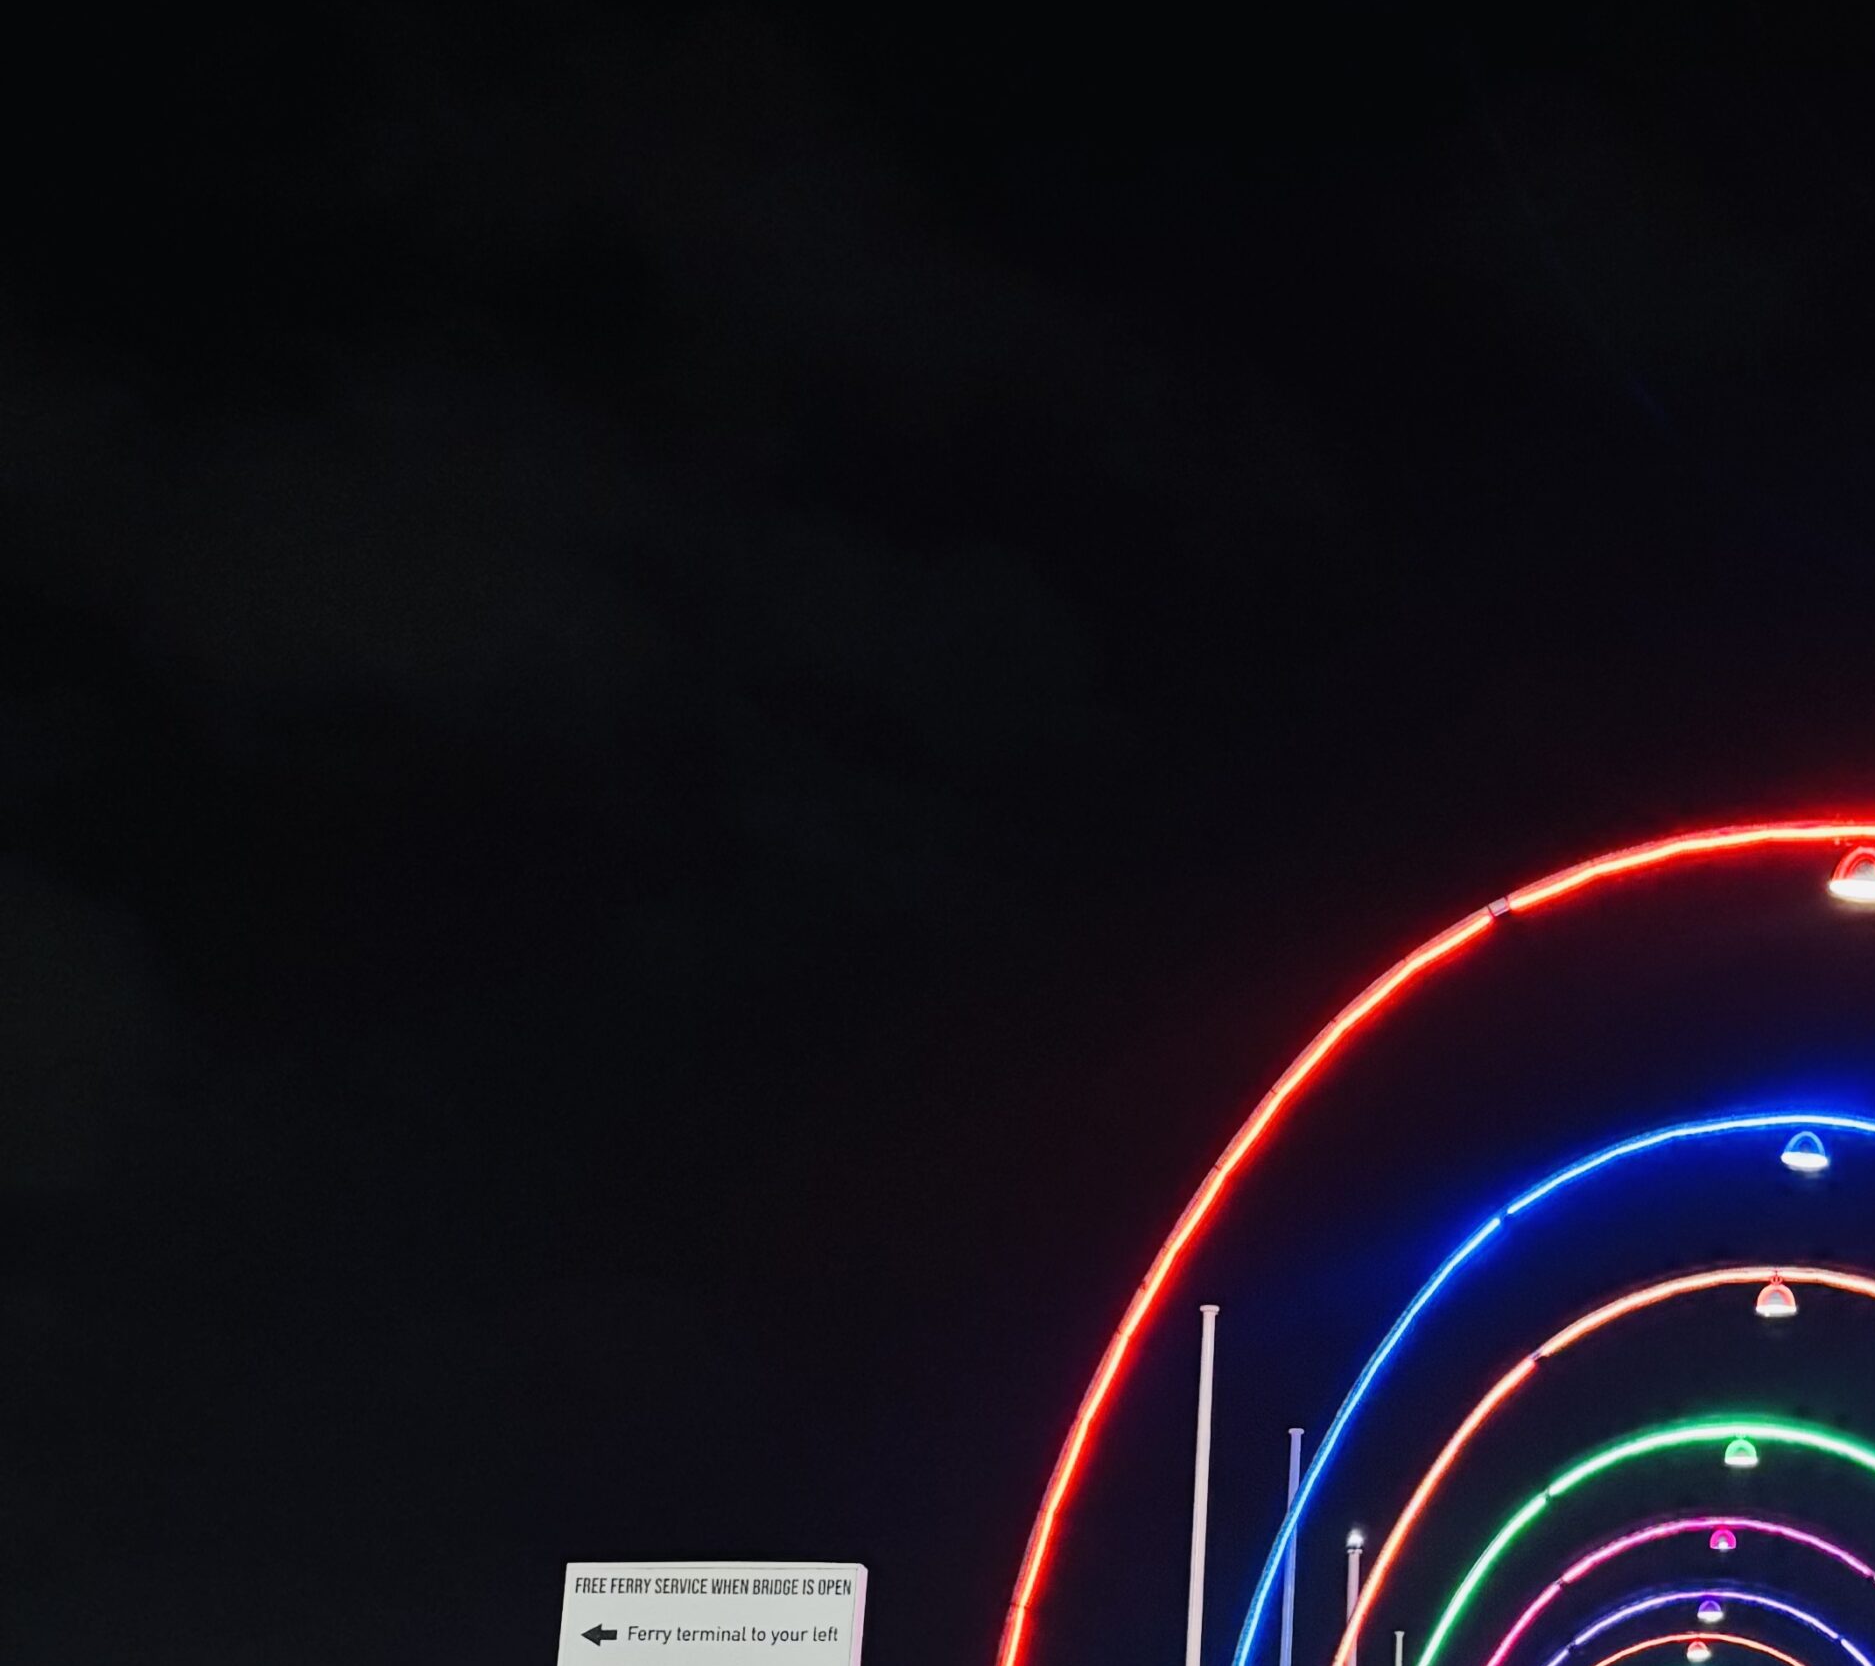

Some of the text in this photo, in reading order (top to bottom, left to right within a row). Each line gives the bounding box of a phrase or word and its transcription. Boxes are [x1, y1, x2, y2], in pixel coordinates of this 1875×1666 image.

[575, 1577, 852, 1595] FREE FERRY SERVICE WHEN BRIDGE IS OPEN
[628, 1626, 839, 1645] Ferry terminal to your left
